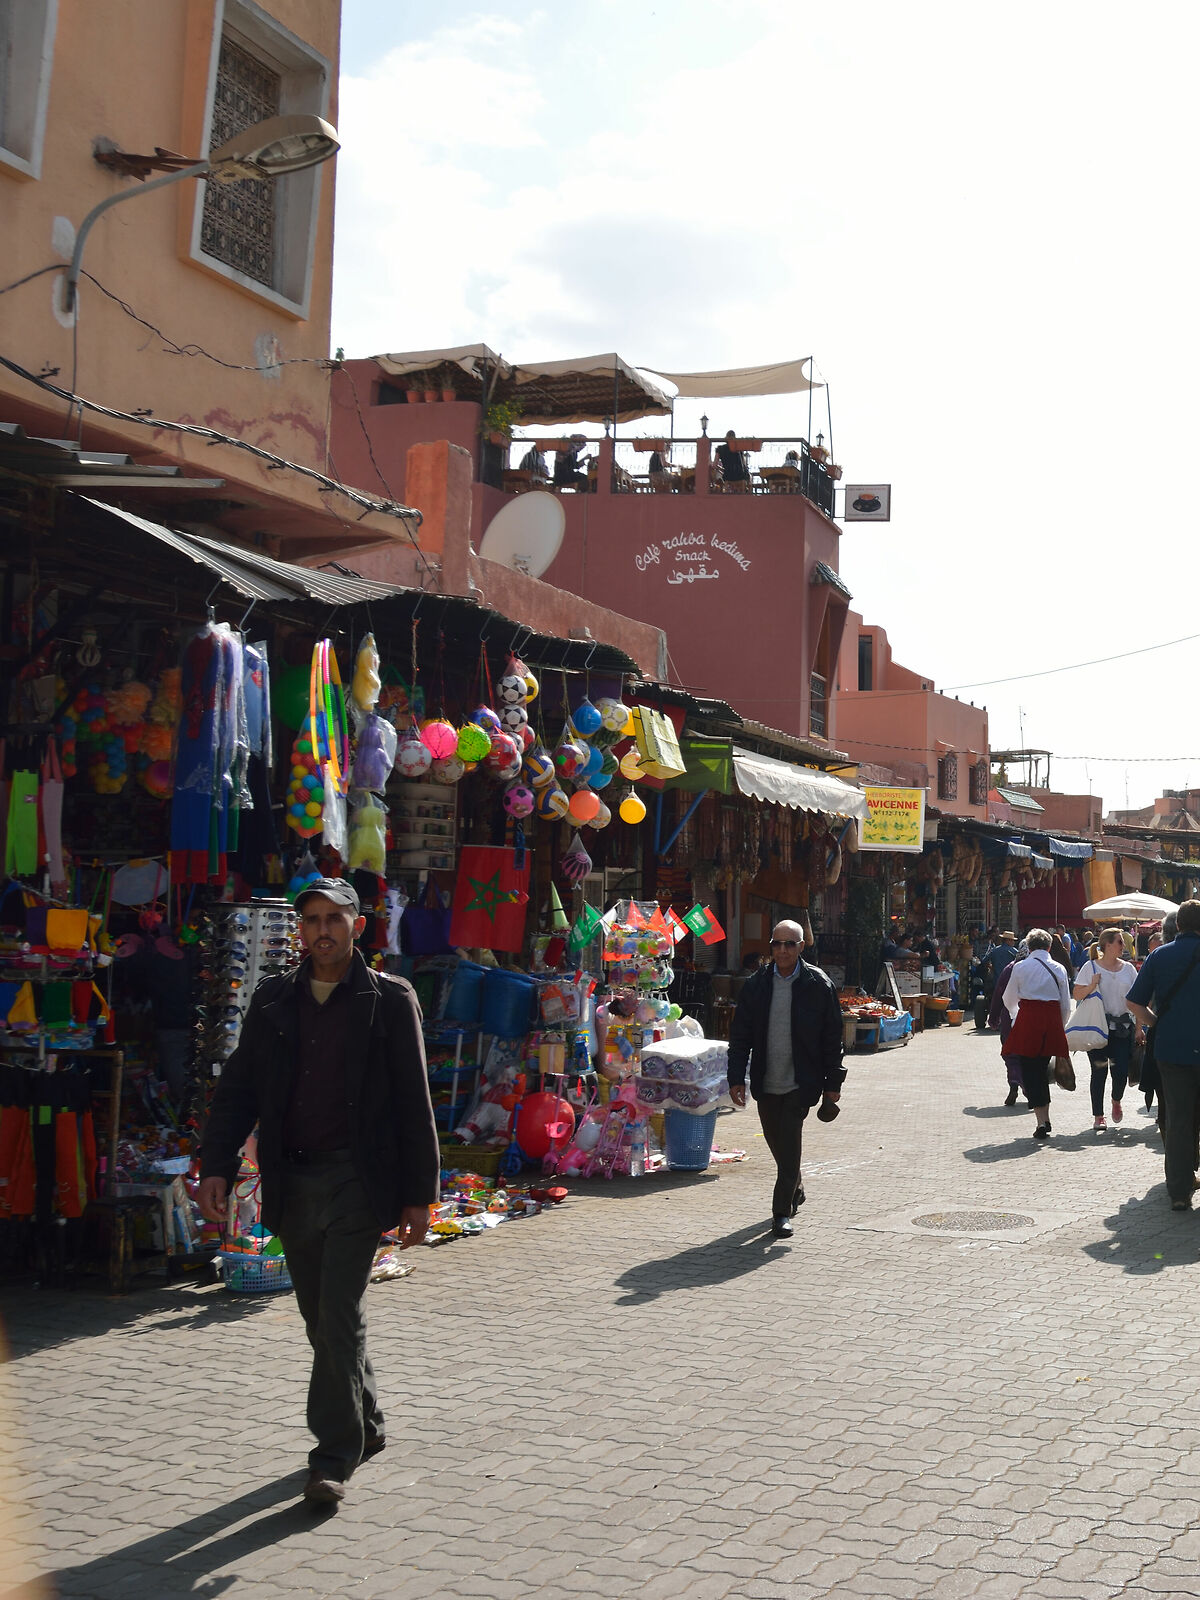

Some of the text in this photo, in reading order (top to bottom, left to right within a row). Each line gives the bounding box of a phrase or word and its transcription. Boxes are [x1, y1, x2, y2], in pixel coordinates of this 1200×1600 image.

[635, 532, 752, 571] Café rahba kedima
[675, 550, 712, 561] Snack
[667, 564, 720, 584] مقهى
[867, 799, 919, 810] AVICENNE
